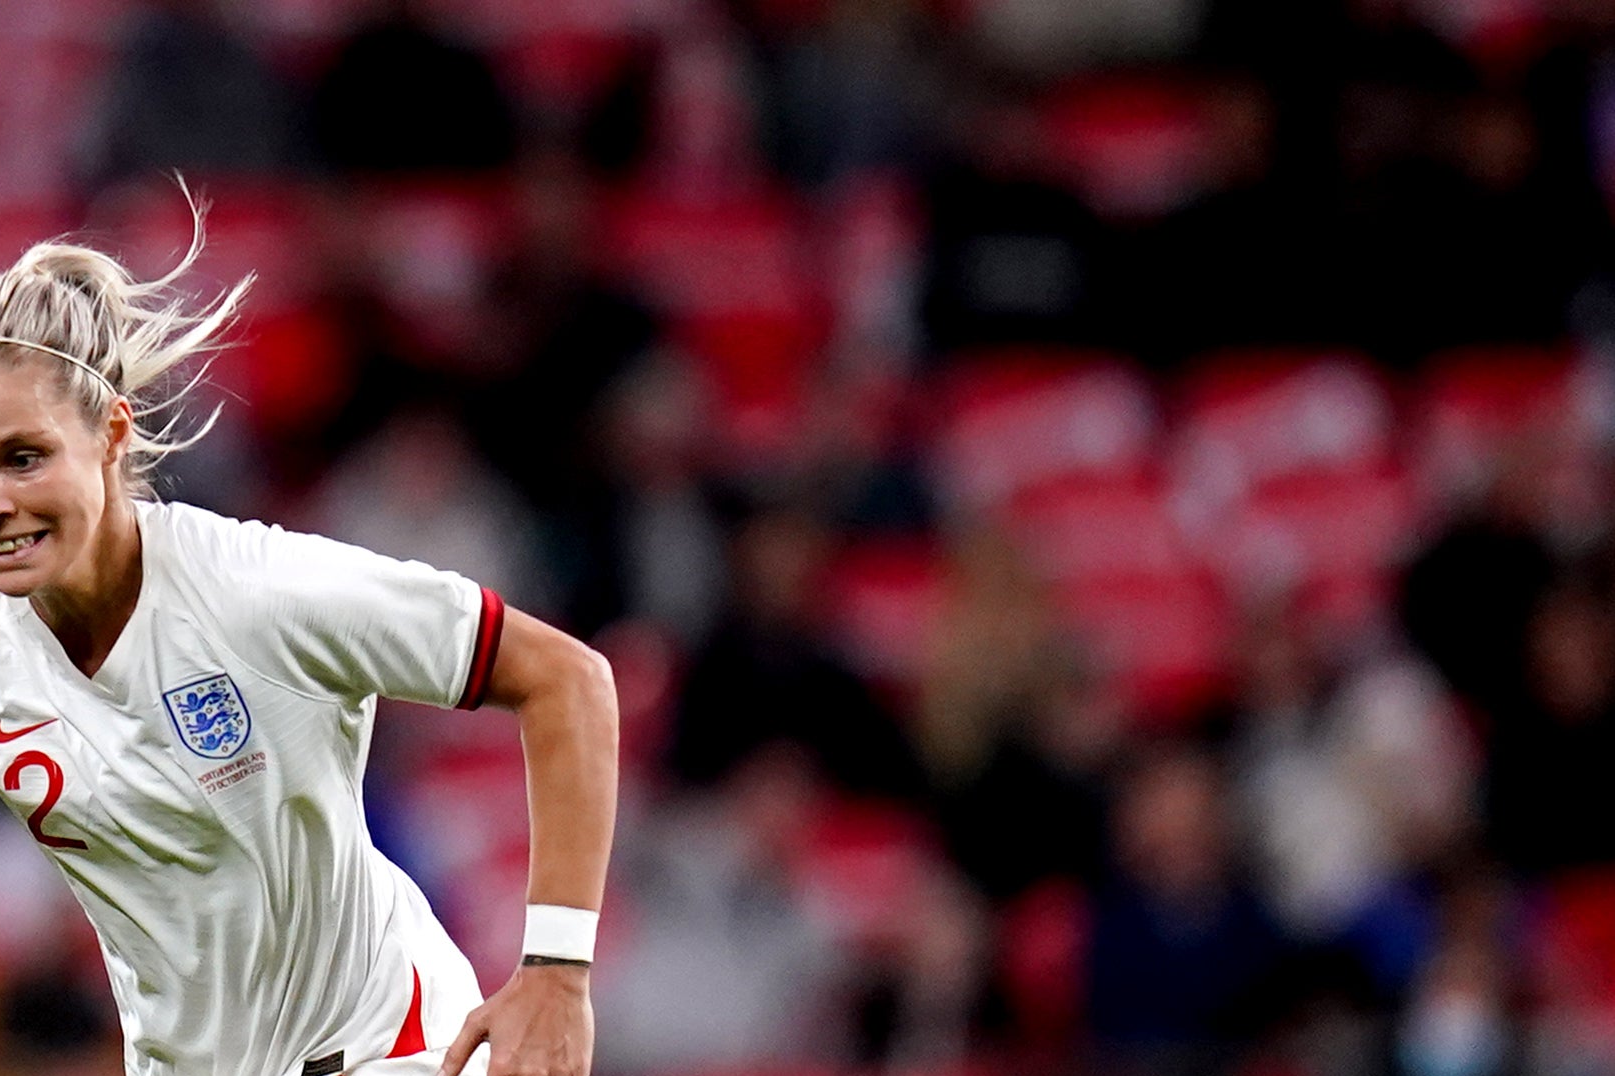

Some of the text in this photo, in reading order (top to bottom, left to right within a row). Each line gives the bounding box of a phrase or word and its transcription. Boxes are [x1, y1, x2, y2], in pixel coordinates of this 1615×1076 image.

[197, 752, 266, 785] NORTHERN IRELAND
[216, 769, 250, 789] OCTOBER
[3, 750, 89, 850] 2
